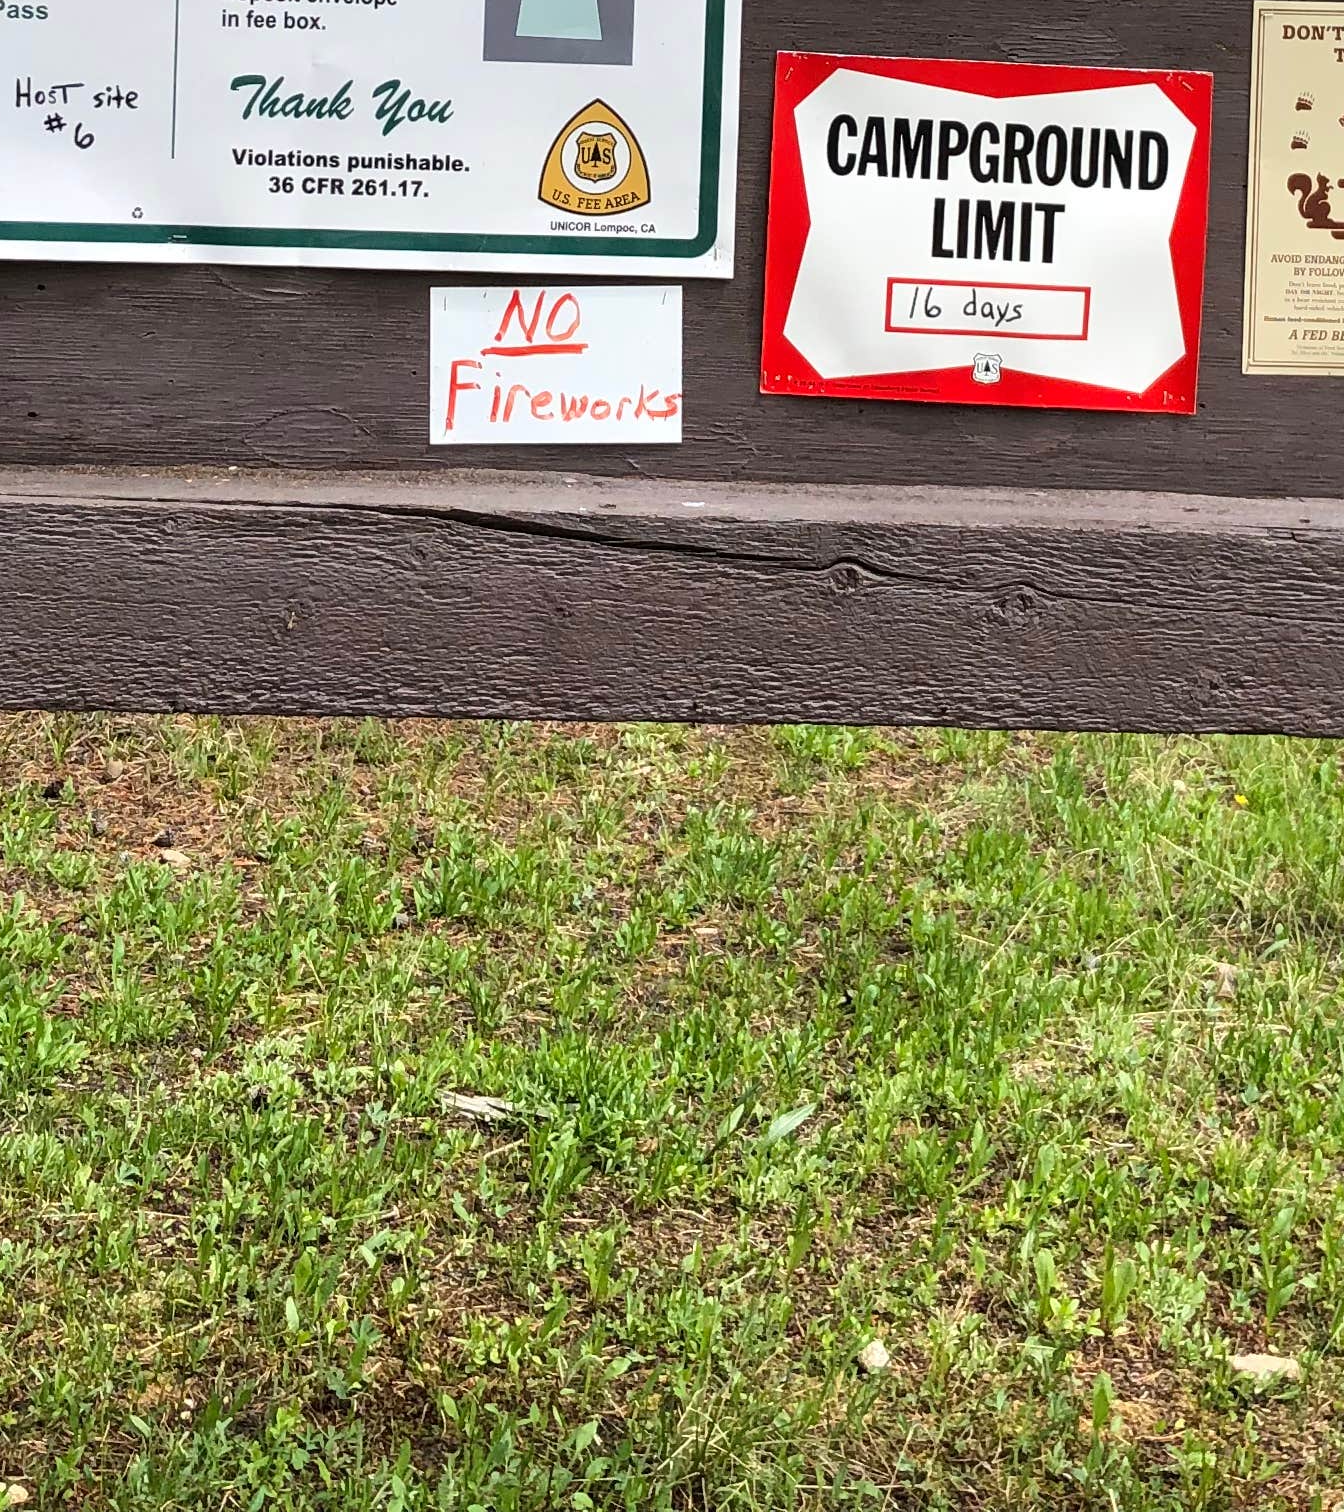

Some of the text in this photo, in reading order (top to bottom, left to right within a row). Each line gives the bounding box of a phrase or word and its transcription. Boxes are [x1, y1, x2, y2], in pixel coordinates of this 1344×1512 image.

[1282, 25, 1344, 42] DON'T
[93, 86, 139, 109] site
[231, 75, 454, 135] Thank You
[232, 149, 469, 172] Violations punishable.
[827, 114, 1169, 190] CAMPGROUND
[269, 177, 428, 198] 36 CFR 261.17.
[552, 189, 640, 209] U.S. FEE AREA
[550, 221, 656, 234] UNICOR Lompoc, CA
[932, 198, 1065, 263] LIMIT
[910, 287, 1023, 326] 16 days
[1289, 330, 1298, 340] A
[1302, 330, 1327, 341] FED
[445, 360, 682, 430] Fireworks
